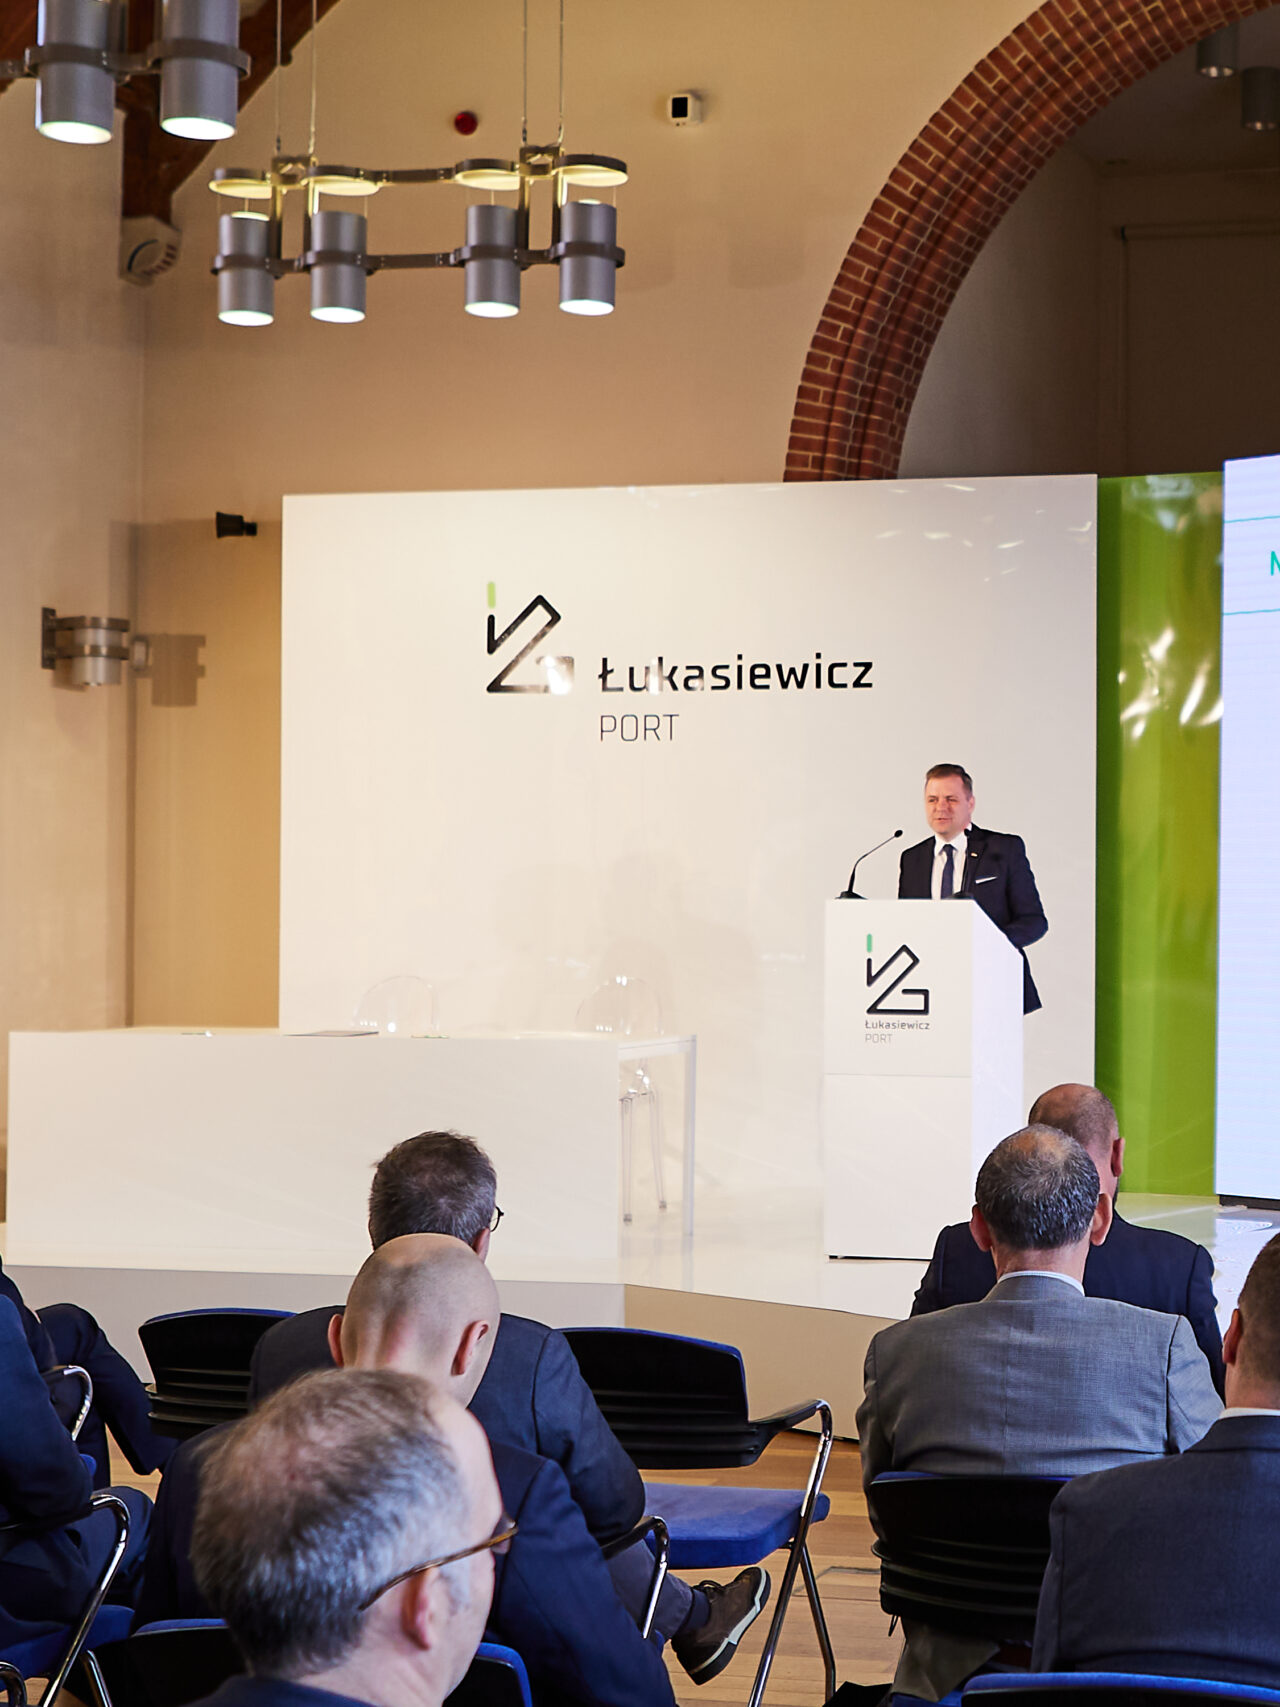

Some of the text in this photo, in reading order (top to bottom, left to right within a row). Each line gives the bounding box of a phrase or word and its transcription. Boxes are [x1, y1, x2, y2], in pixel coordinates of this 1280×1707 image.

[598, 653, 874, 693] Łukasiewicz
[600, 714, 680, 742] PORT
[865, 1020, 930, 1030] Łukasiewicz
[864, 1033, 893, 1044] PORT
